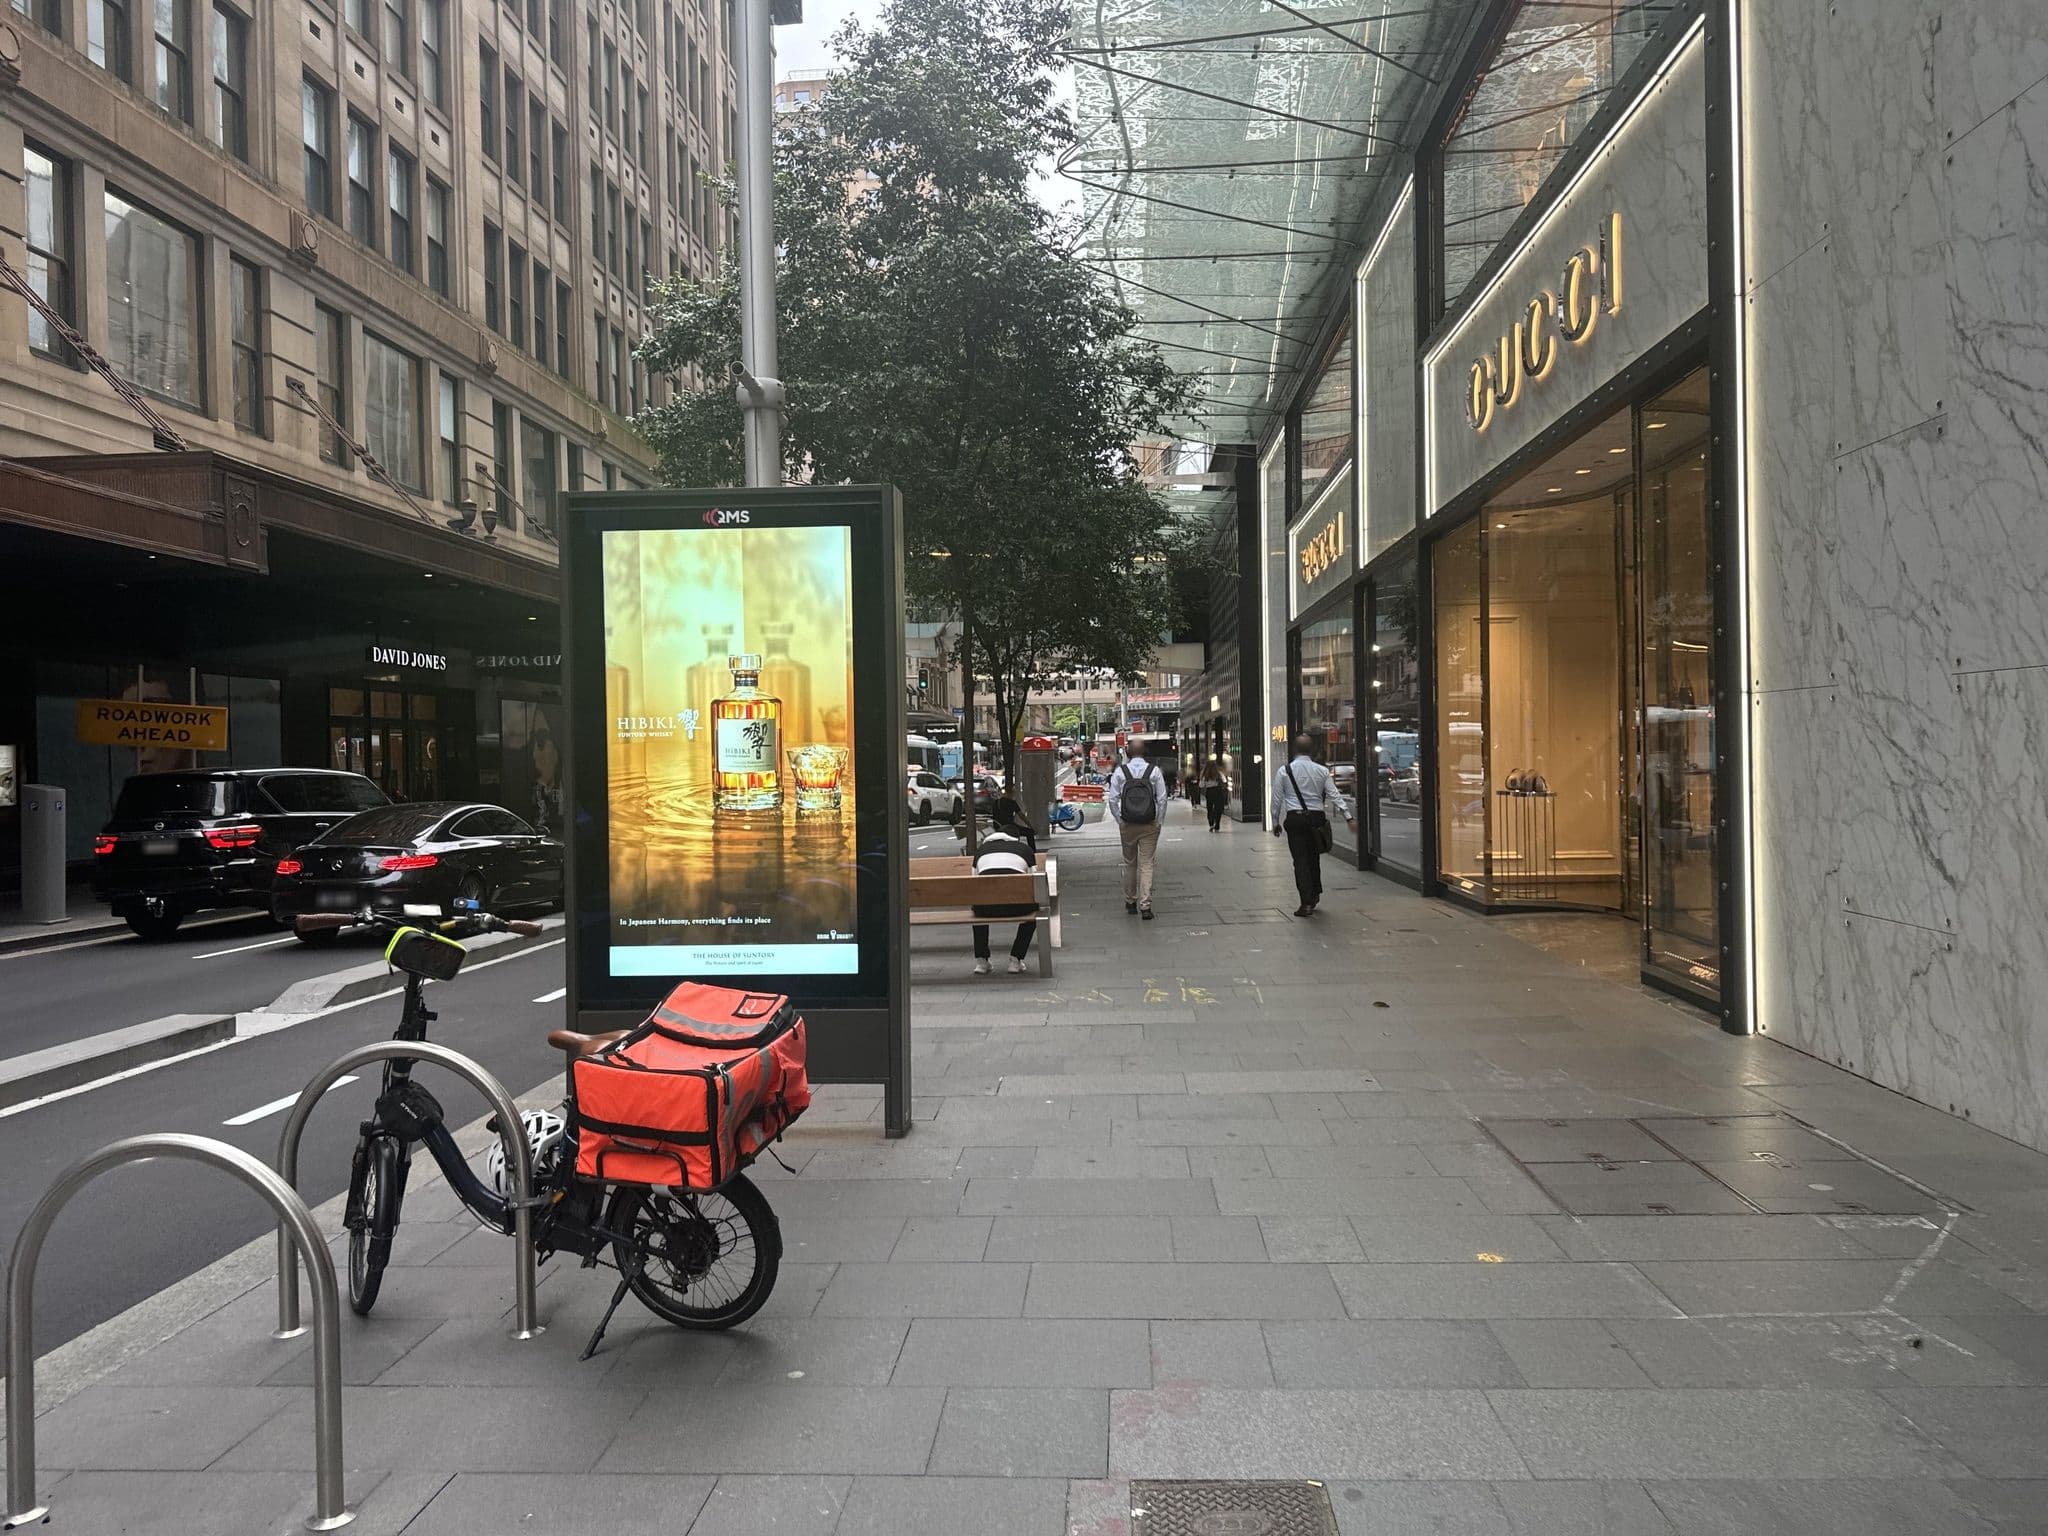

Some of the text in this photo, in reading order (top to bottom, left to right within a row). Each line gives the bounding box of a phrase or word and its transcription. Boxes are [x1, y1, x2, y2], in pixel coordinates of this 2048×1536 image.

[1464, 212, 1622, 432] GUCCI
[372, 646, 447, 671] DAVID JONES
[97, 707, 212, 726] ROADWORK
[117, 726, 192, 743] AHEAD
[628, 918, 656, 927] Japanese
[658, 917, 691, 926] Harmony,
[692, 917, 726, 925] everything
[727, 916, 743, 924] finds
[754, 916, 771, 925] place
